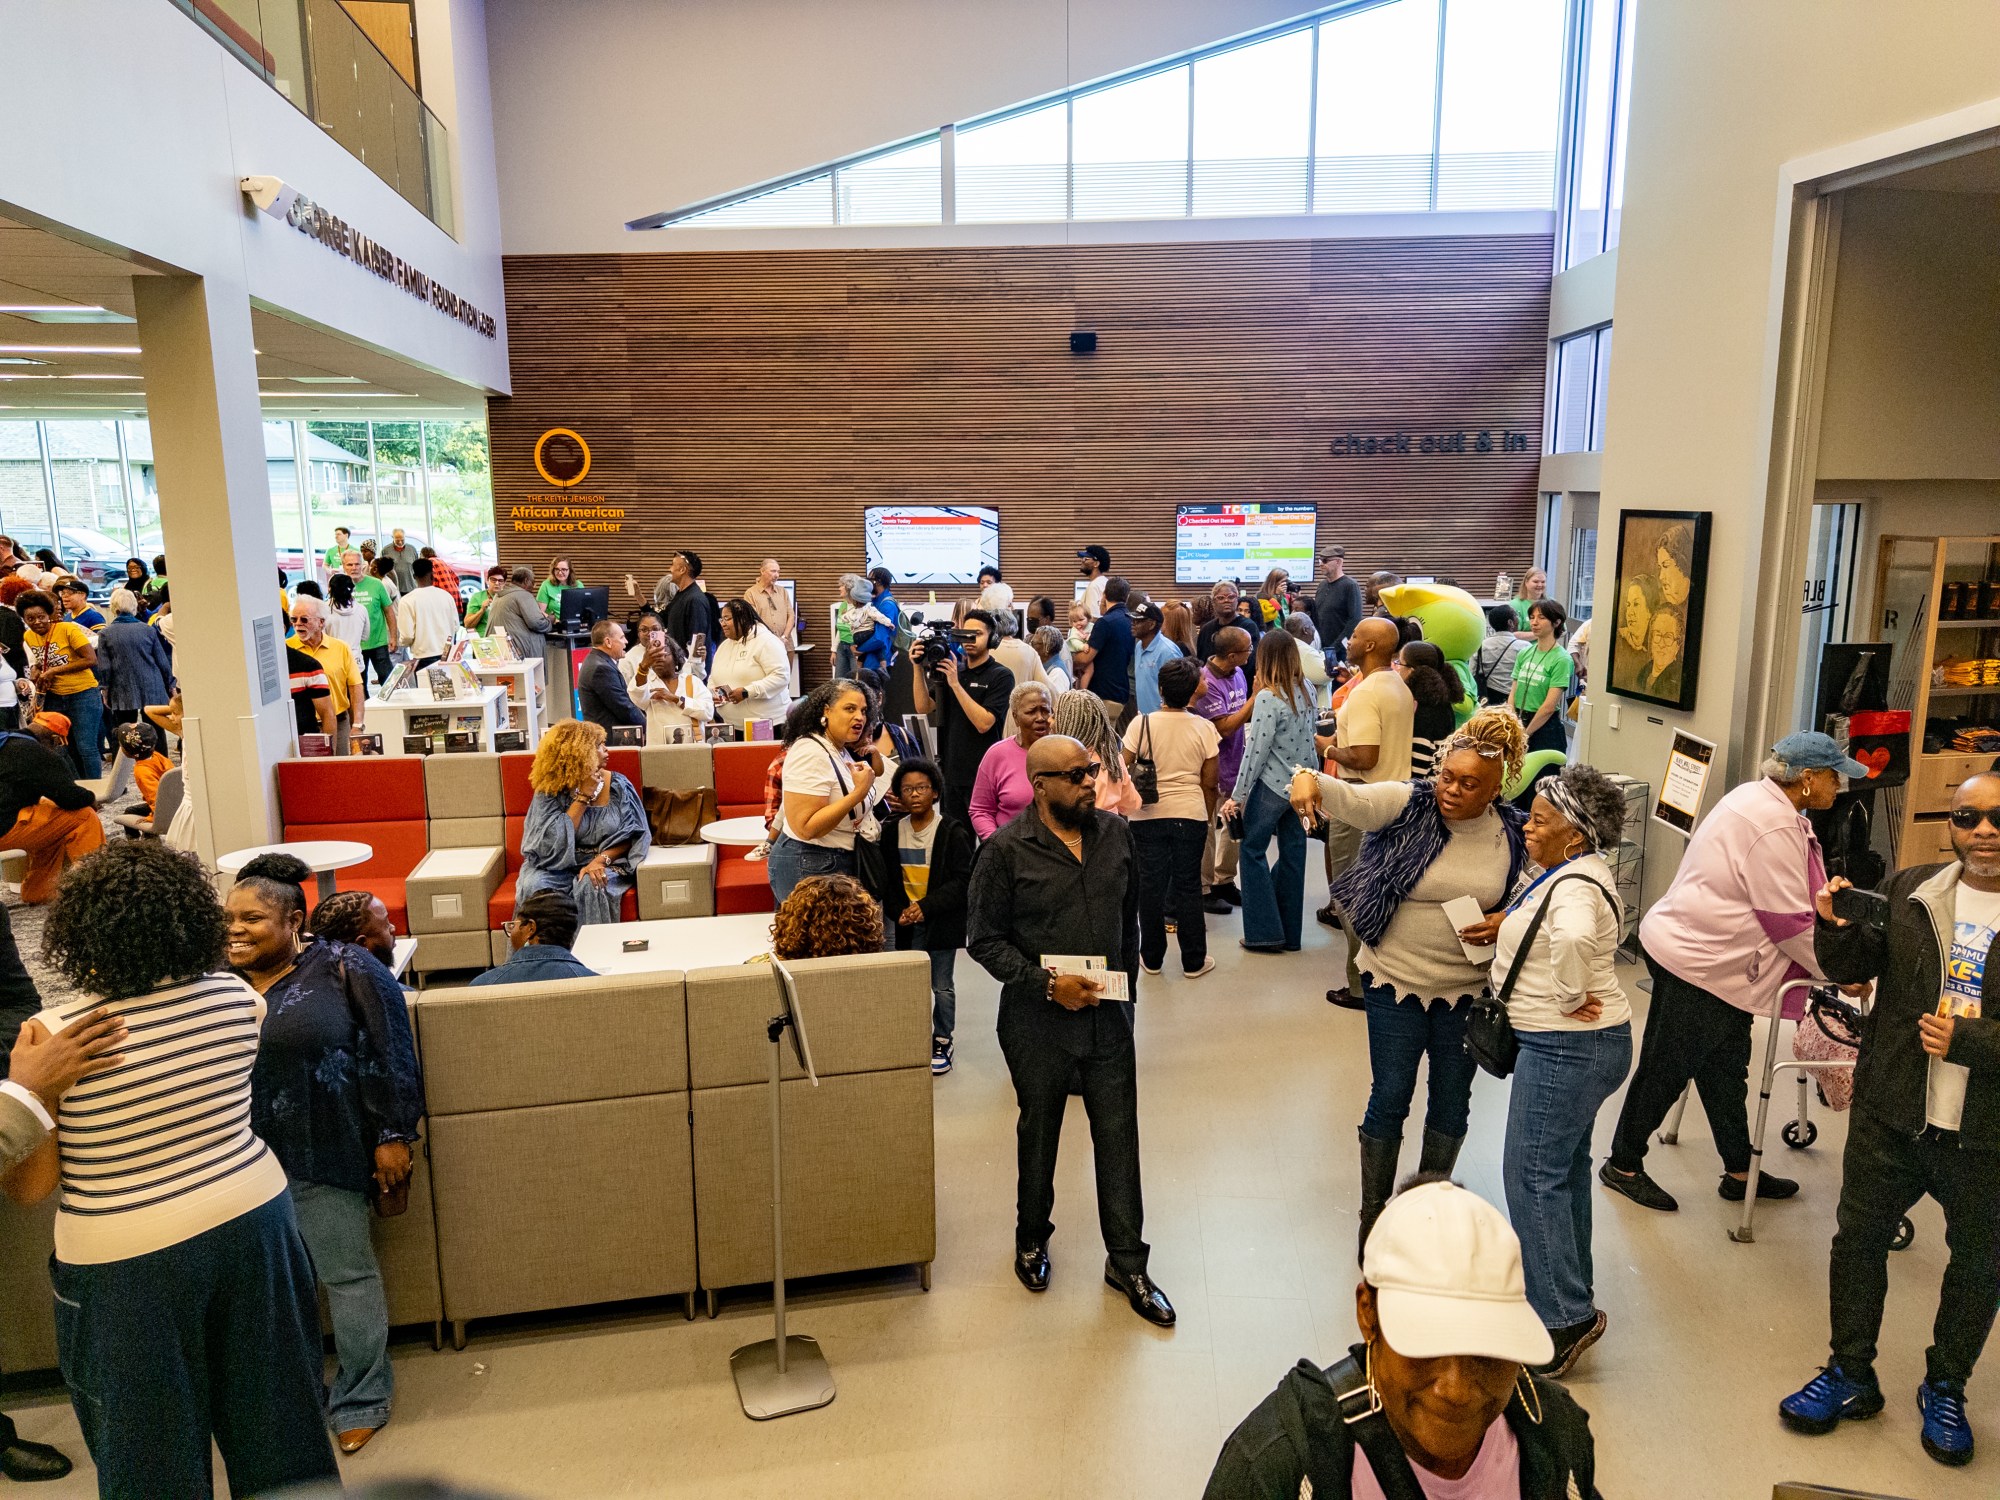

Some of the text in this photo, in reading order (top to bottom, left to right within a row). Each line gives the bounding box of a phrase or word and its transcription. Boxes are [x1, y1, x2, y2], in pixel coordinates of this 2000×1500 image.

[349, 227, 396, 283] KAISER
[393, 256, 429, 303] FAMILY
[430, 280, 479, 330] FOUNDATION
[1331, 430, 1528, 454] check out & in
[570, 495, 605, 503] JEMISON
[511, 506, 625, 518] African American
[514, 521, 622, 532] Resource Center
[1956, 983, 1963, 992] &
